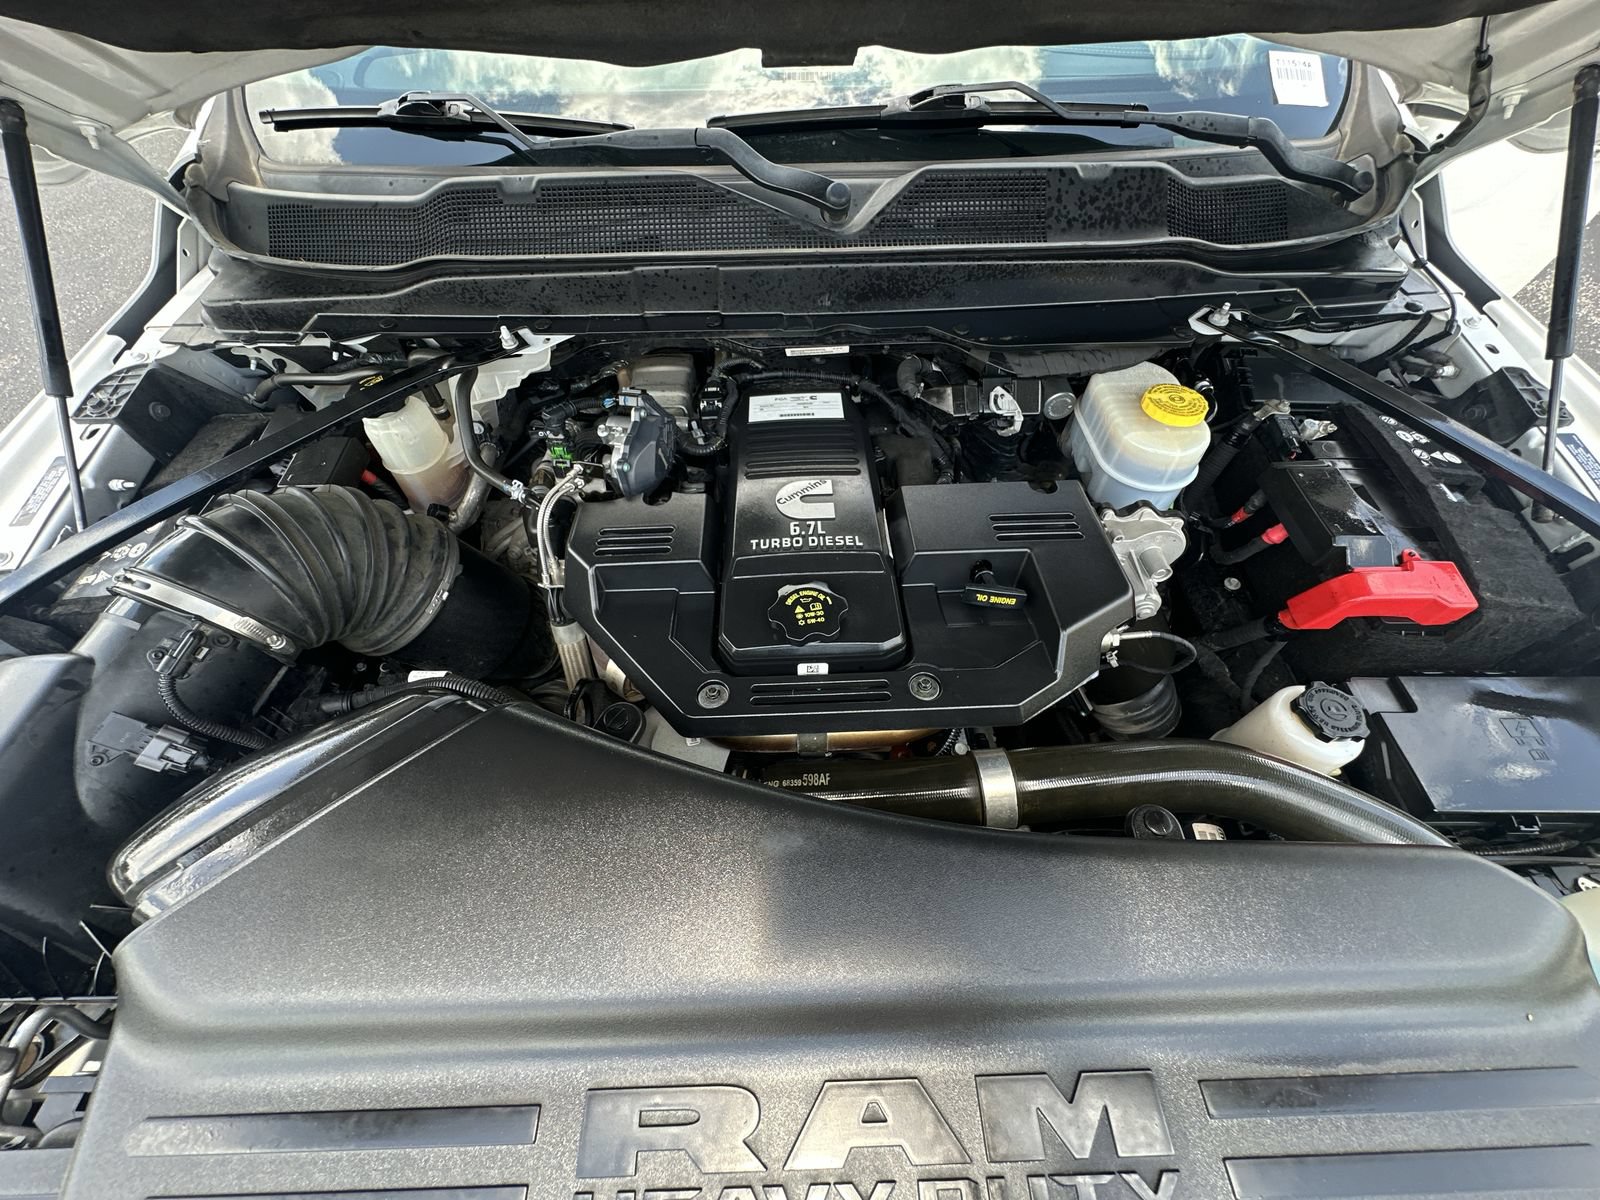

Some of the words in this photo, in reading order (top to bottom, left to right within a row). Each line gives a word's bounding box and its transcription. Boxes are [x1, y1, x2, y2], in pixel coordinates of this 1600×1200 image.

[776, 479, 828, 505] Cummins
[789, 521, 826, 536] 6.7L
[750, 537, 803, 550] TURBO
[808, 536, 864, 547] DIESEL
[976, 593, 988, 602] OIL
[989, 596, 1016, 605] ENGINE
[576, 1070, 1175, 1178] RAM
